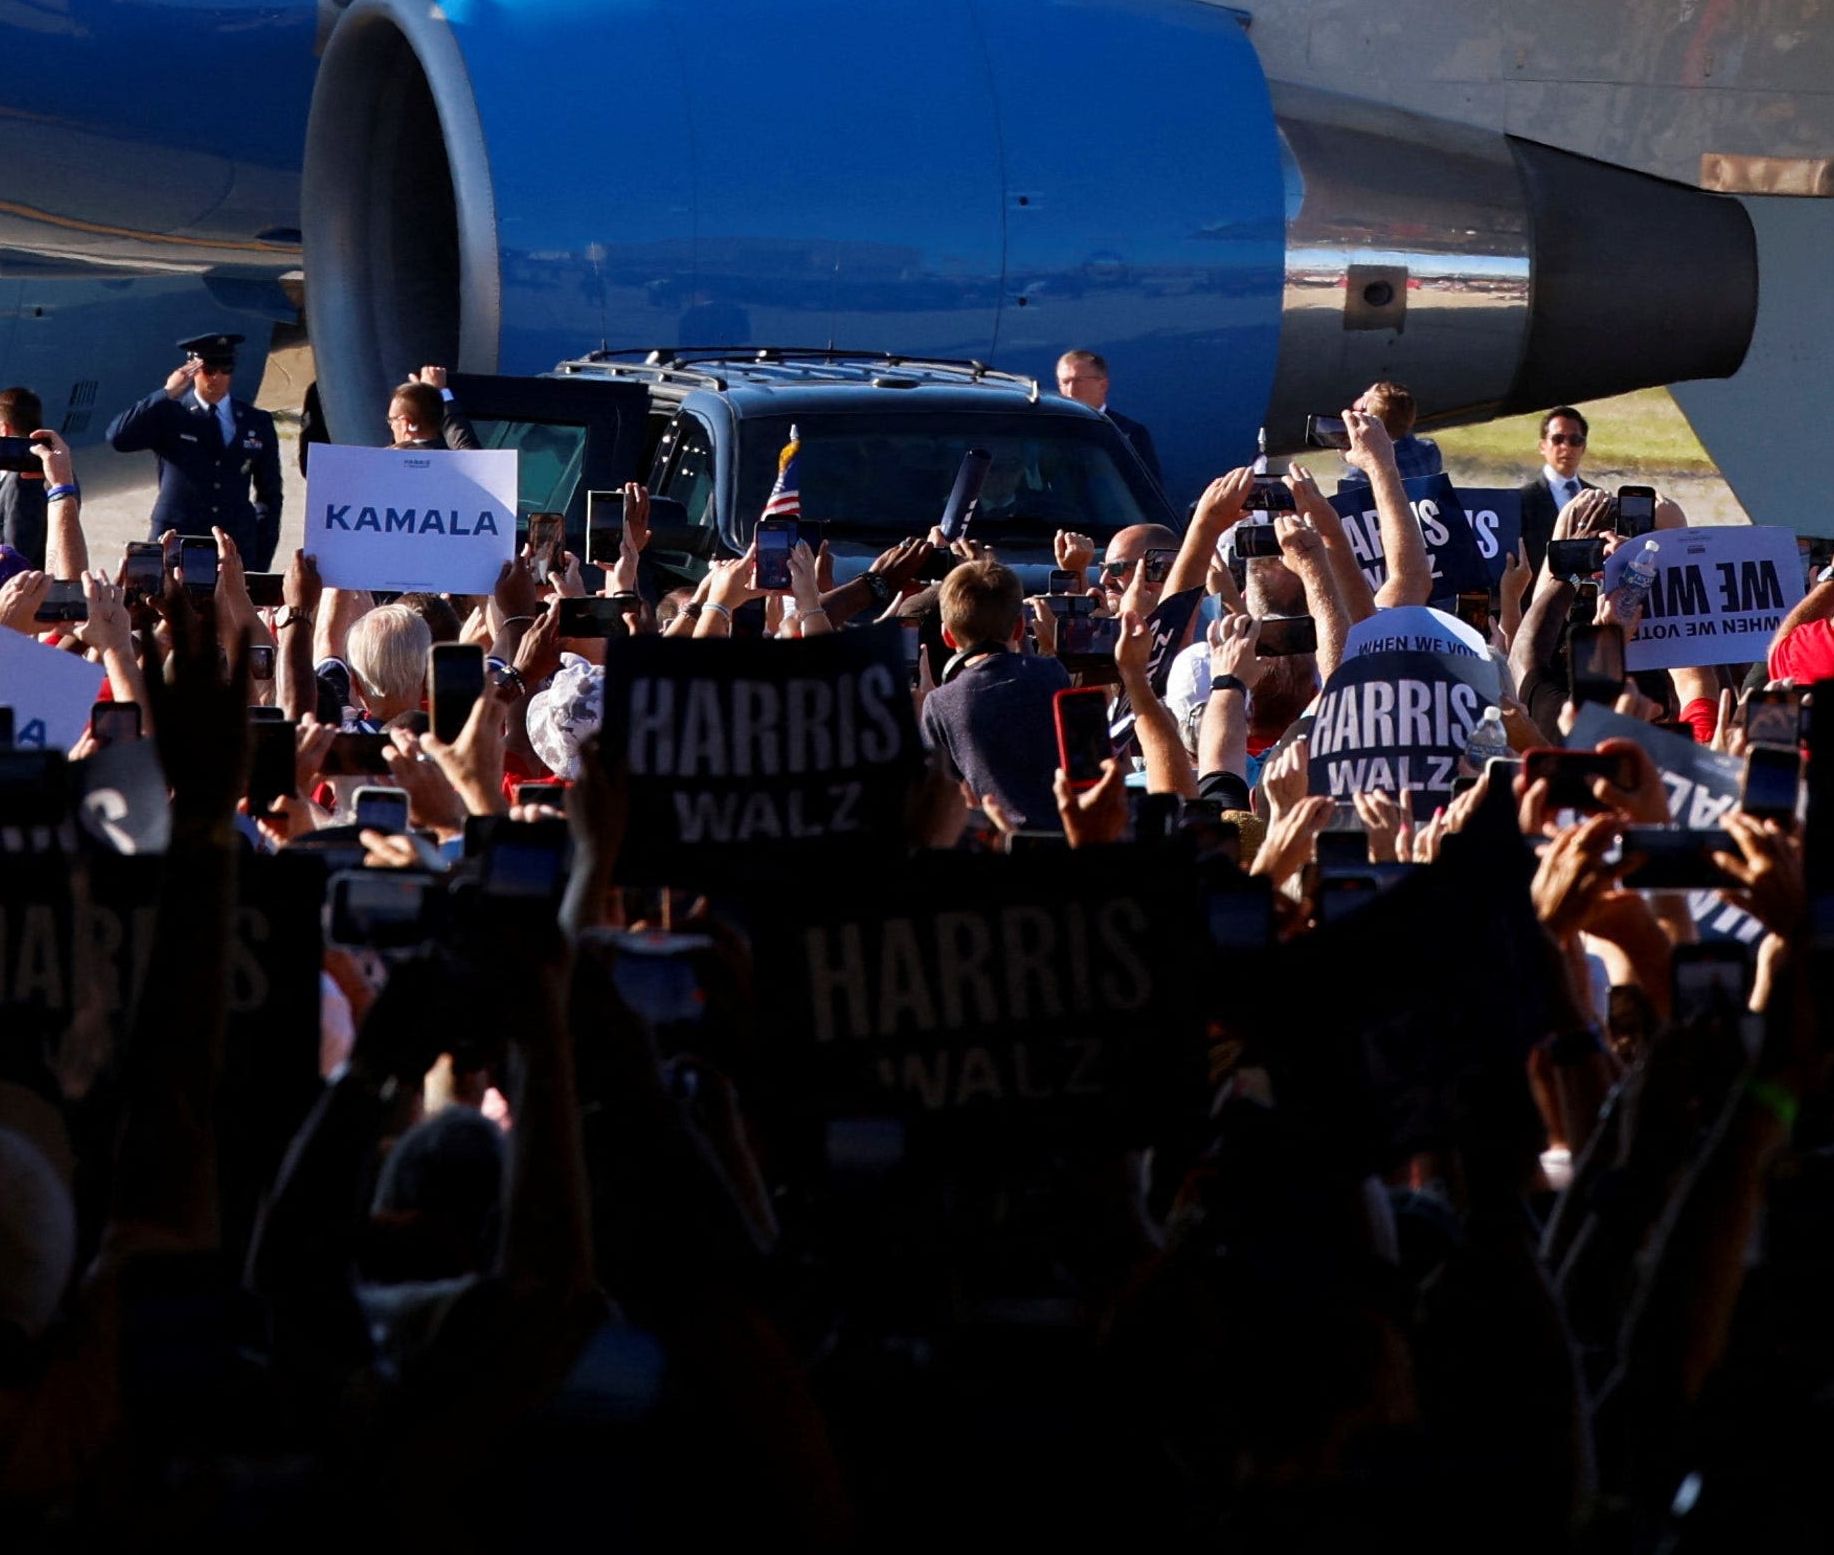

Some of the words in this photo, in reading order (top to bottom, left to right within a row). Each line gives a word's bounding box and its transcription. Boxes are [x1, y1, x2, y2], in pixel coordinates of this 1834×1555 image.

[325, 504, 499, 537] KAMALA
[1716, 560, 1786, 613] WE
[1414, 636, 1444, 653] WE
[1685, 620, 1718, 636] WE
[626, 661, 904, 780] HARRIS
[1309, 679, 1478, 760] HARRIS
[1327, 754, 1456, 796] WALZ
[670, 780, 868, 844] WALZ
[803, 894, 1156, 1044] HARRIS
